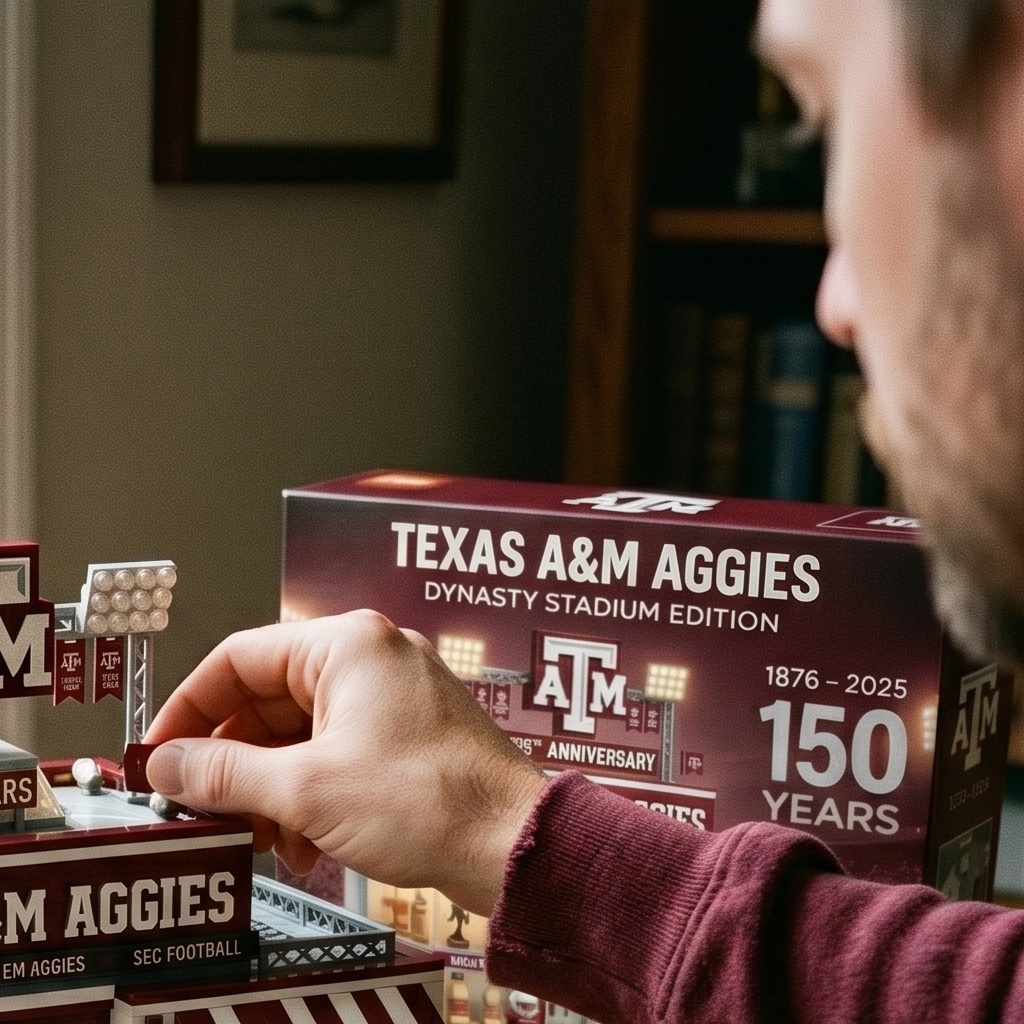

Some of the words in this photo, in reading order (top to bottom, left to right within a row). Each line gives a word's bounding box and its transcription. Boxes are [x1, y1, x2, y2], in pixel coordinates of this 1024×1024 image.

[390, 521, 525, 578] TEXAS
[537, 533, 639, 588] A&M
[651, 545, 821, 603] AGGIES
[424, 580, 538, 611] DYNASTY
[544, 592, 660, 622] STADIUM
[669, 604, 779, 633] EDITION
[765, 665, 819, 690] 1876
[845, 673, 908, 699] 2025
[547, 740, 656, 772] ANNIVERSARY
[759, 699, 908, 795] 150
[761, 789, 900, 836] YEARS
[64, 871, 235, 938] AGGIES
[30, 955, 86, 978] AGGIES
[133, 947, 163, 966] SEC
[167, 939, 242, 963] FOOTBALL
